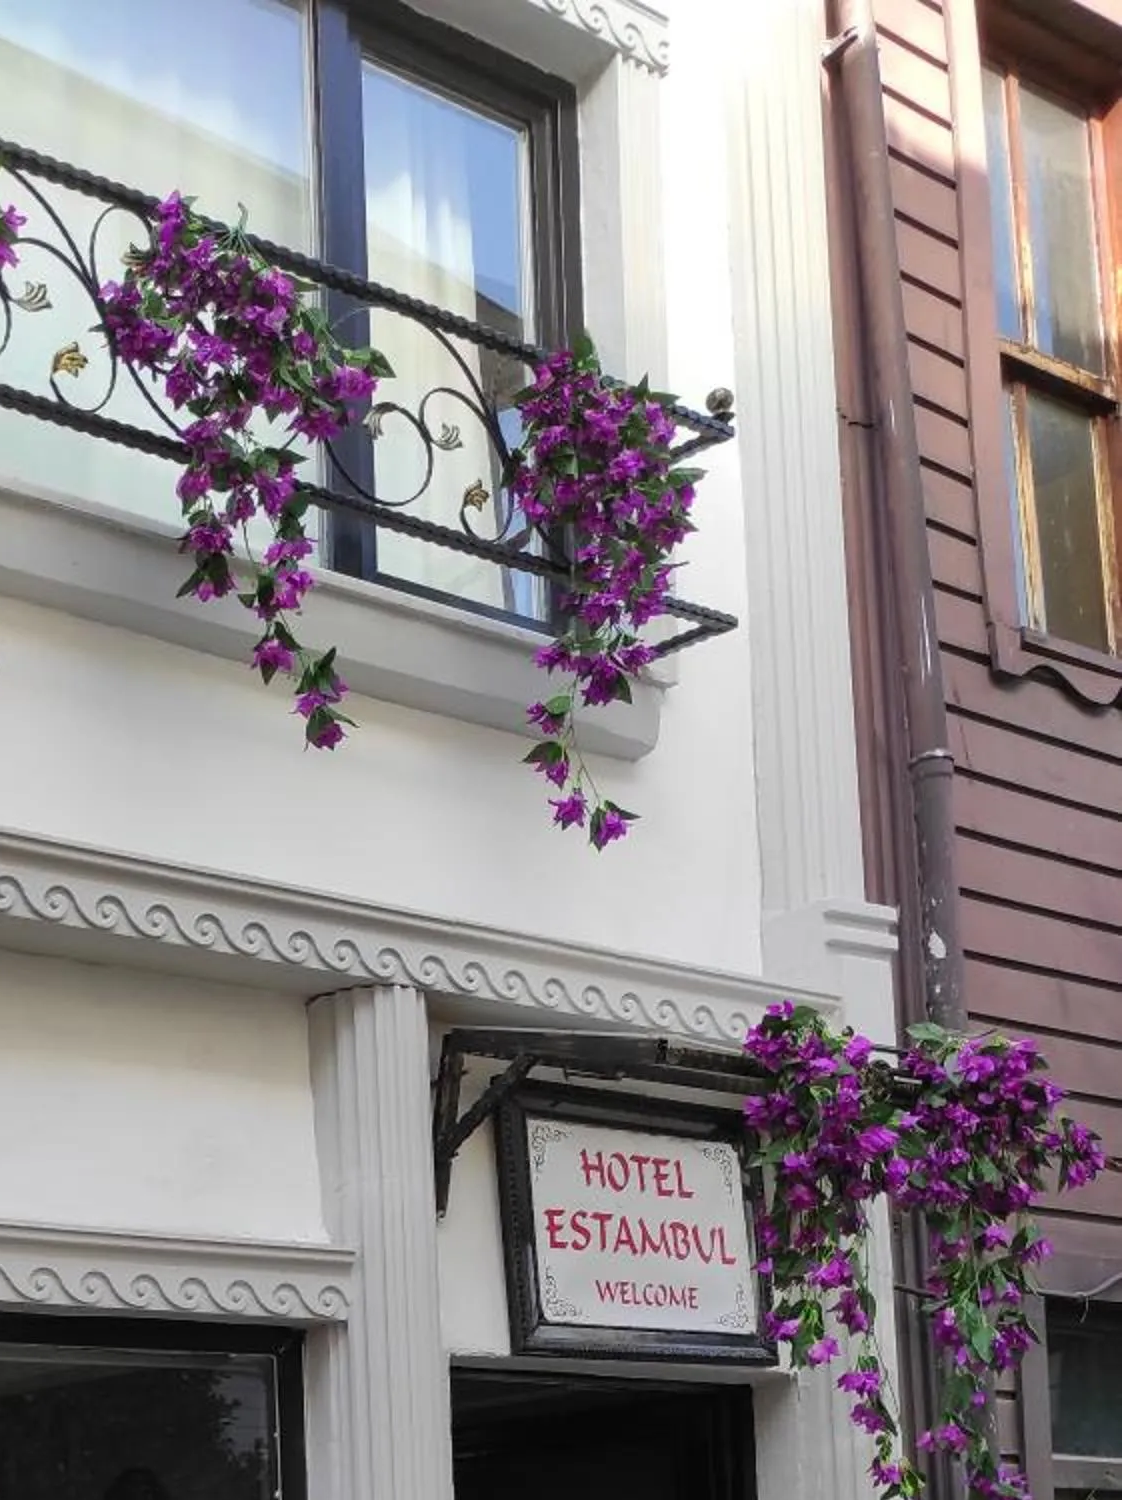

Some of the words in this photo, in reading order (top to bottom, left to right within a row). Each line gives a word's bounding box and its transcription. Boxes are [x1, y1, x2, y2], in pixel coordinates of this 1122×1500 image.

[580, 1148, 695, 1199] HOTEL
[544, 1208, 737, 1266] ESTAMBUL
[595, 1279, 699, 1309] WELCOME
